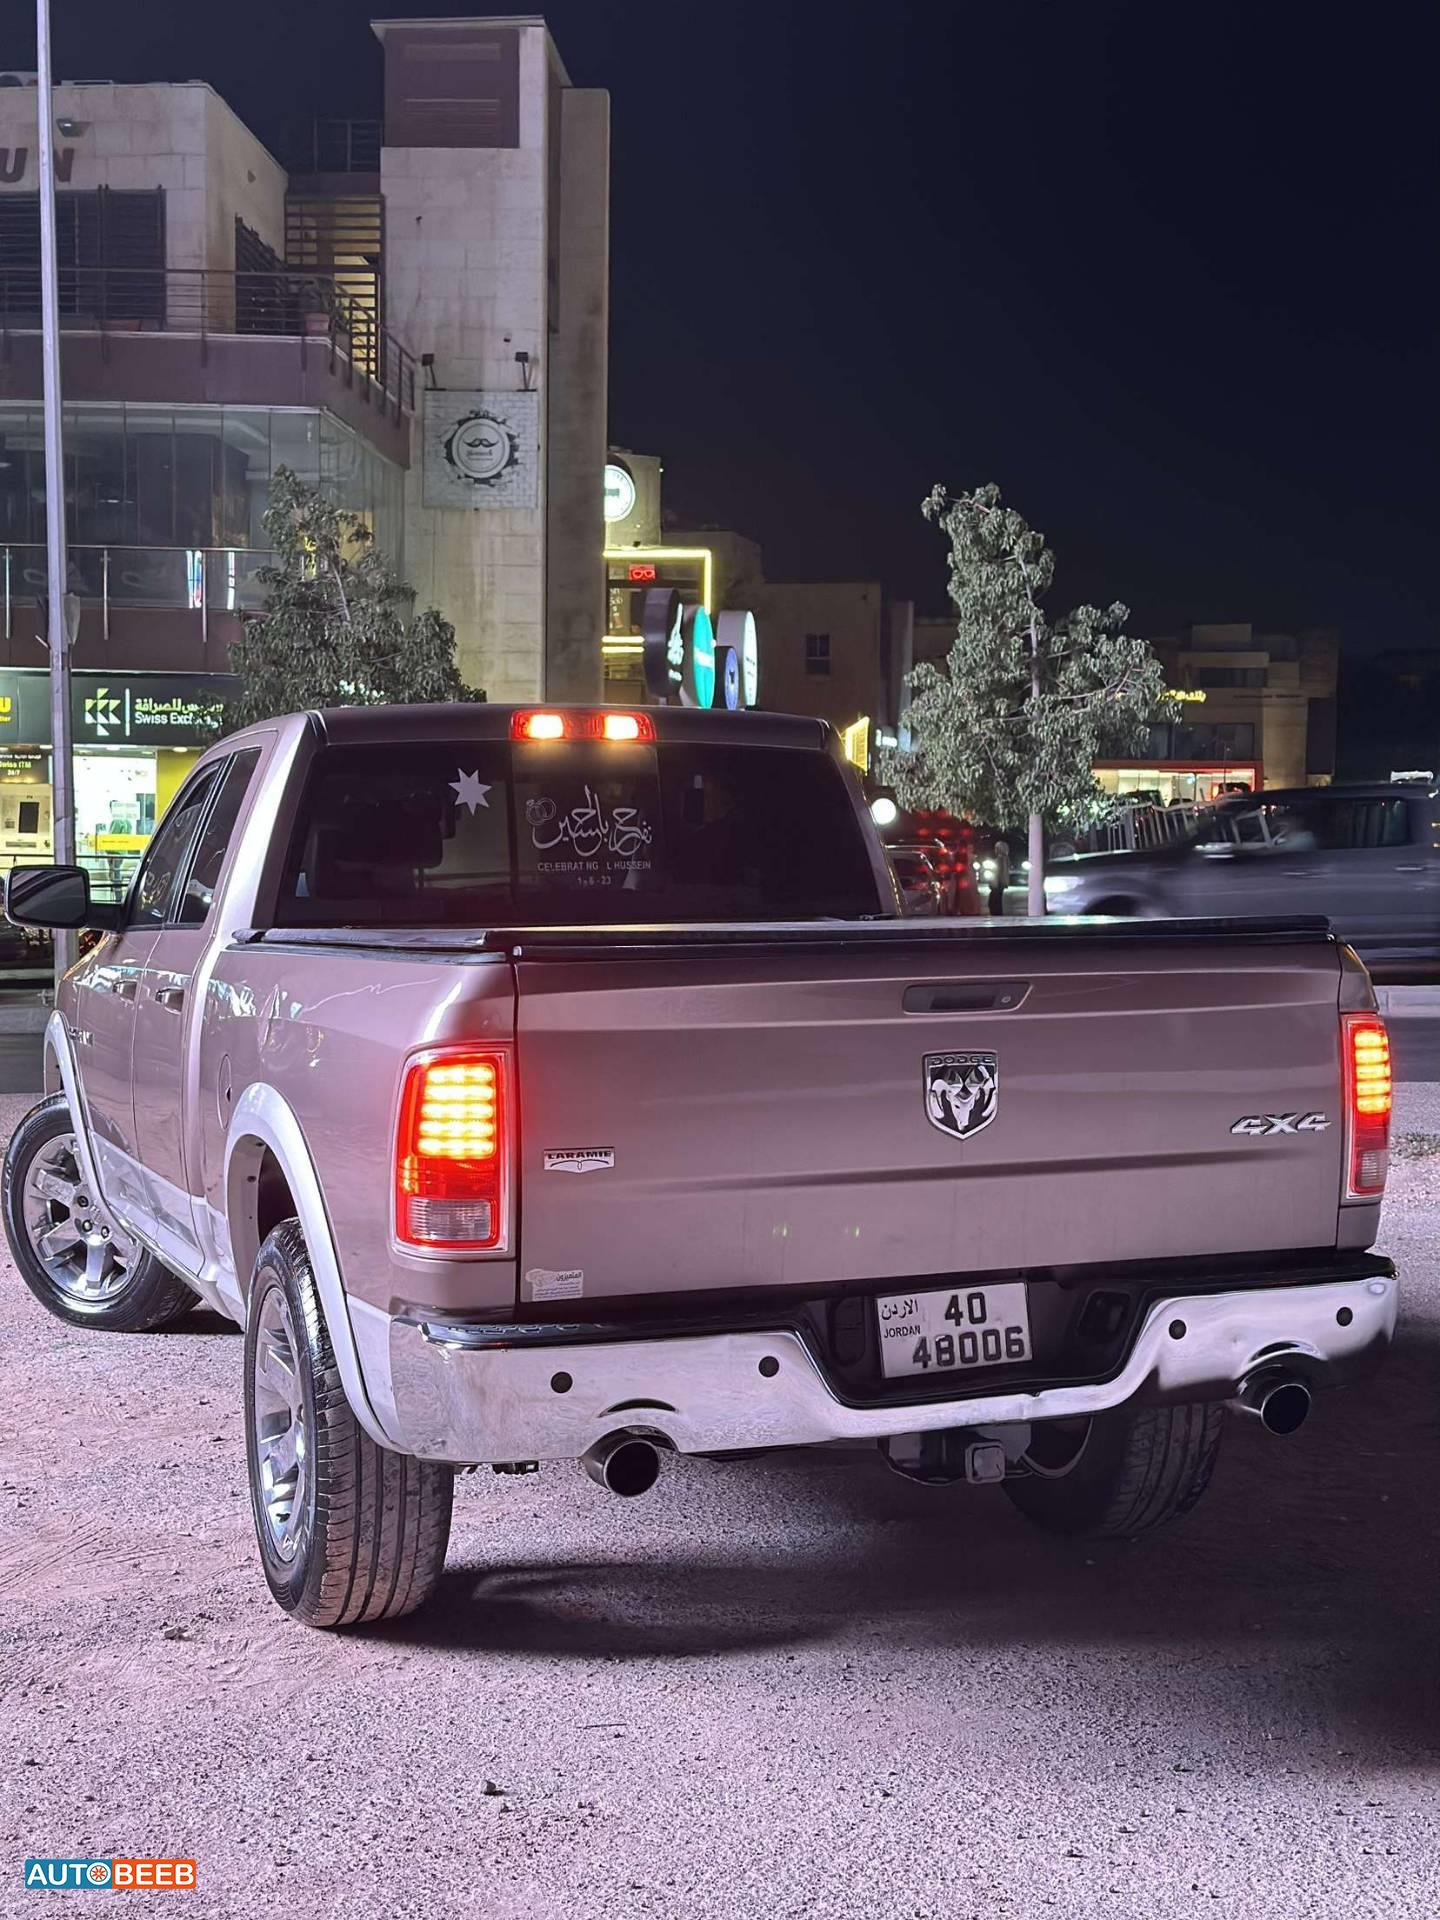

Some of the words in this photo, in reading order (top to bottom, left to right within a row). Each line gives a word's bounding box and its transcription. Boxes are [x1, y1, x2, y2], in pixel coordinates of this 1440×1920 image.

[135, 698, 182, 714] للصرافة
[135, 711, 168, 725] Swiss
[538, 861, 599, 872] CELEBRATNG
[614, 860, 651, 870] HUSSEIN
[930, 1054, 993, 1066] DODGE
[547, 1150, 612, 1160] LARAMIE
[944, 1291, 987, 1327] 40
[884, 1324, 921, 1339] JORDAN
[912, 1325, 1025, 1369] 48006
